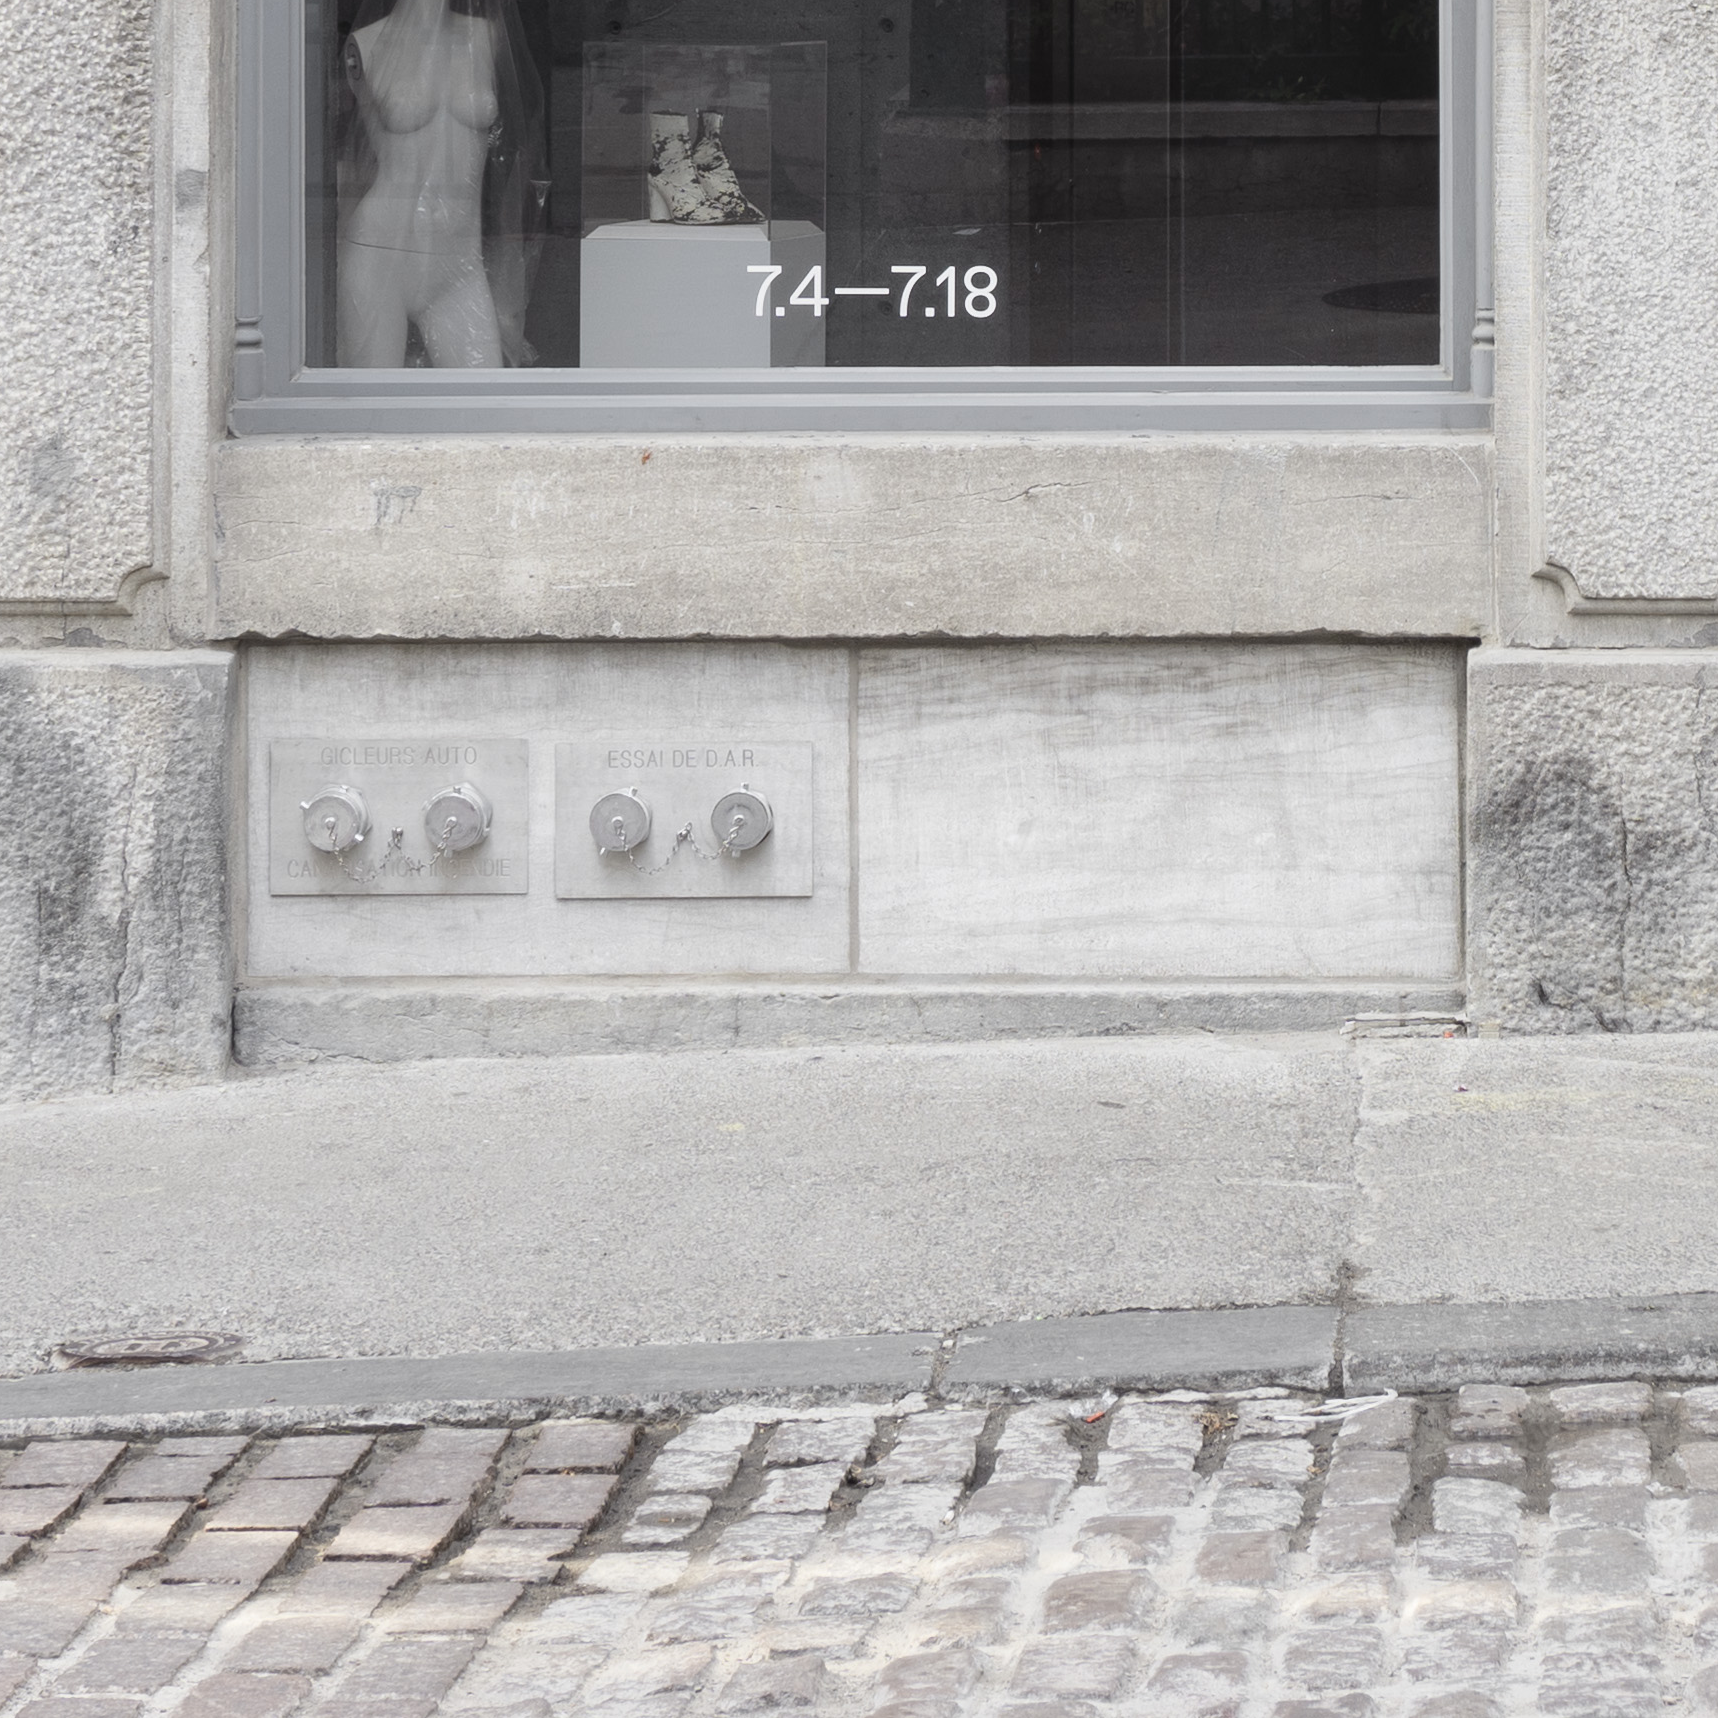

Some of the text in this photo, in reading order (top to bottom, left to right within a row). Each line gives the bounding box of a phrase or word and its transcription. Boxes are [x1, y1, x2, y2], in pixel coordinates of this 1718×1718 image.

[320, 745, 478, 767] GICLEURS AUTO
[607, 749, 760, 769] ESSAI DE D.A.R.
